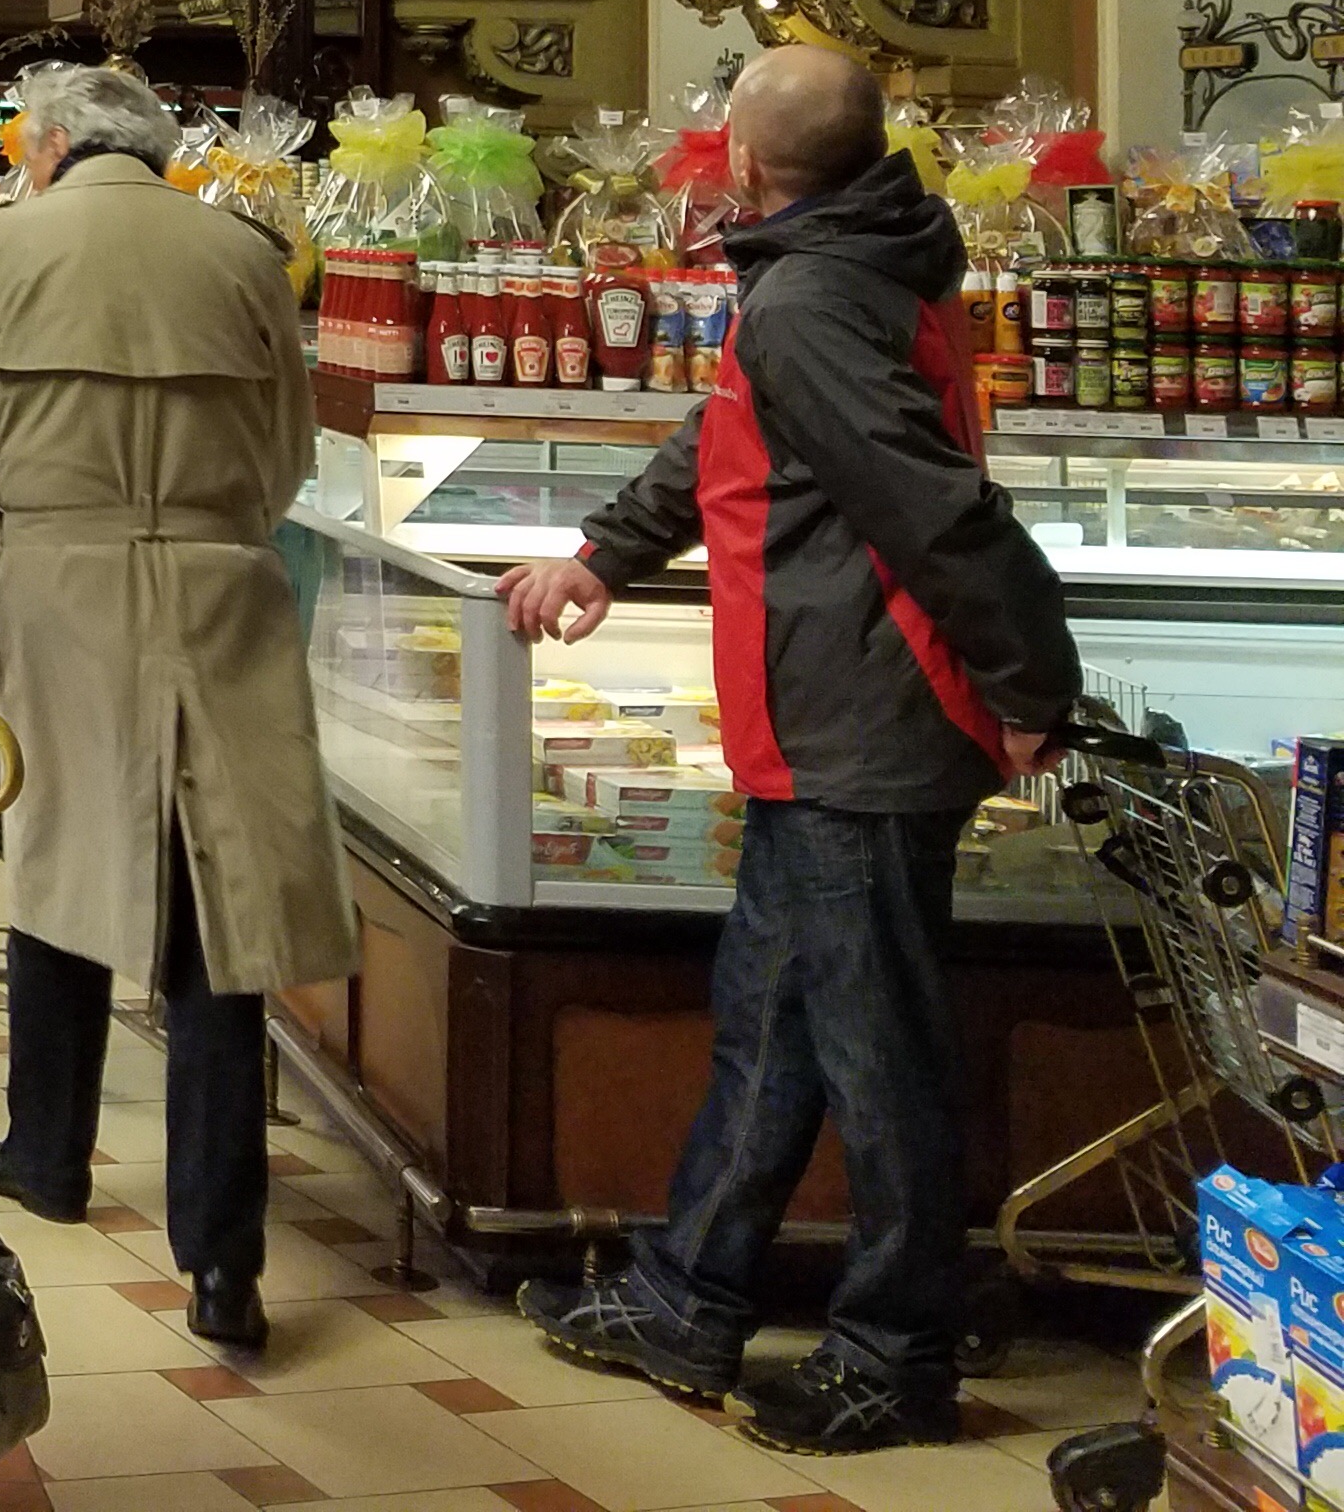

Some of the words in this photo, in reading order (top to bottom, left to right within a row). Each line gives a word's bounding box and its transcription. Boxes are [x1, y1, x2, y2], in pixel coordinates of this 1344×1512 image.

[610, 294, 634, 303] HEINZ
[1206, 1214, 1232, 1248] Рис
[1290, 1275, 1319, 1313] Рис
